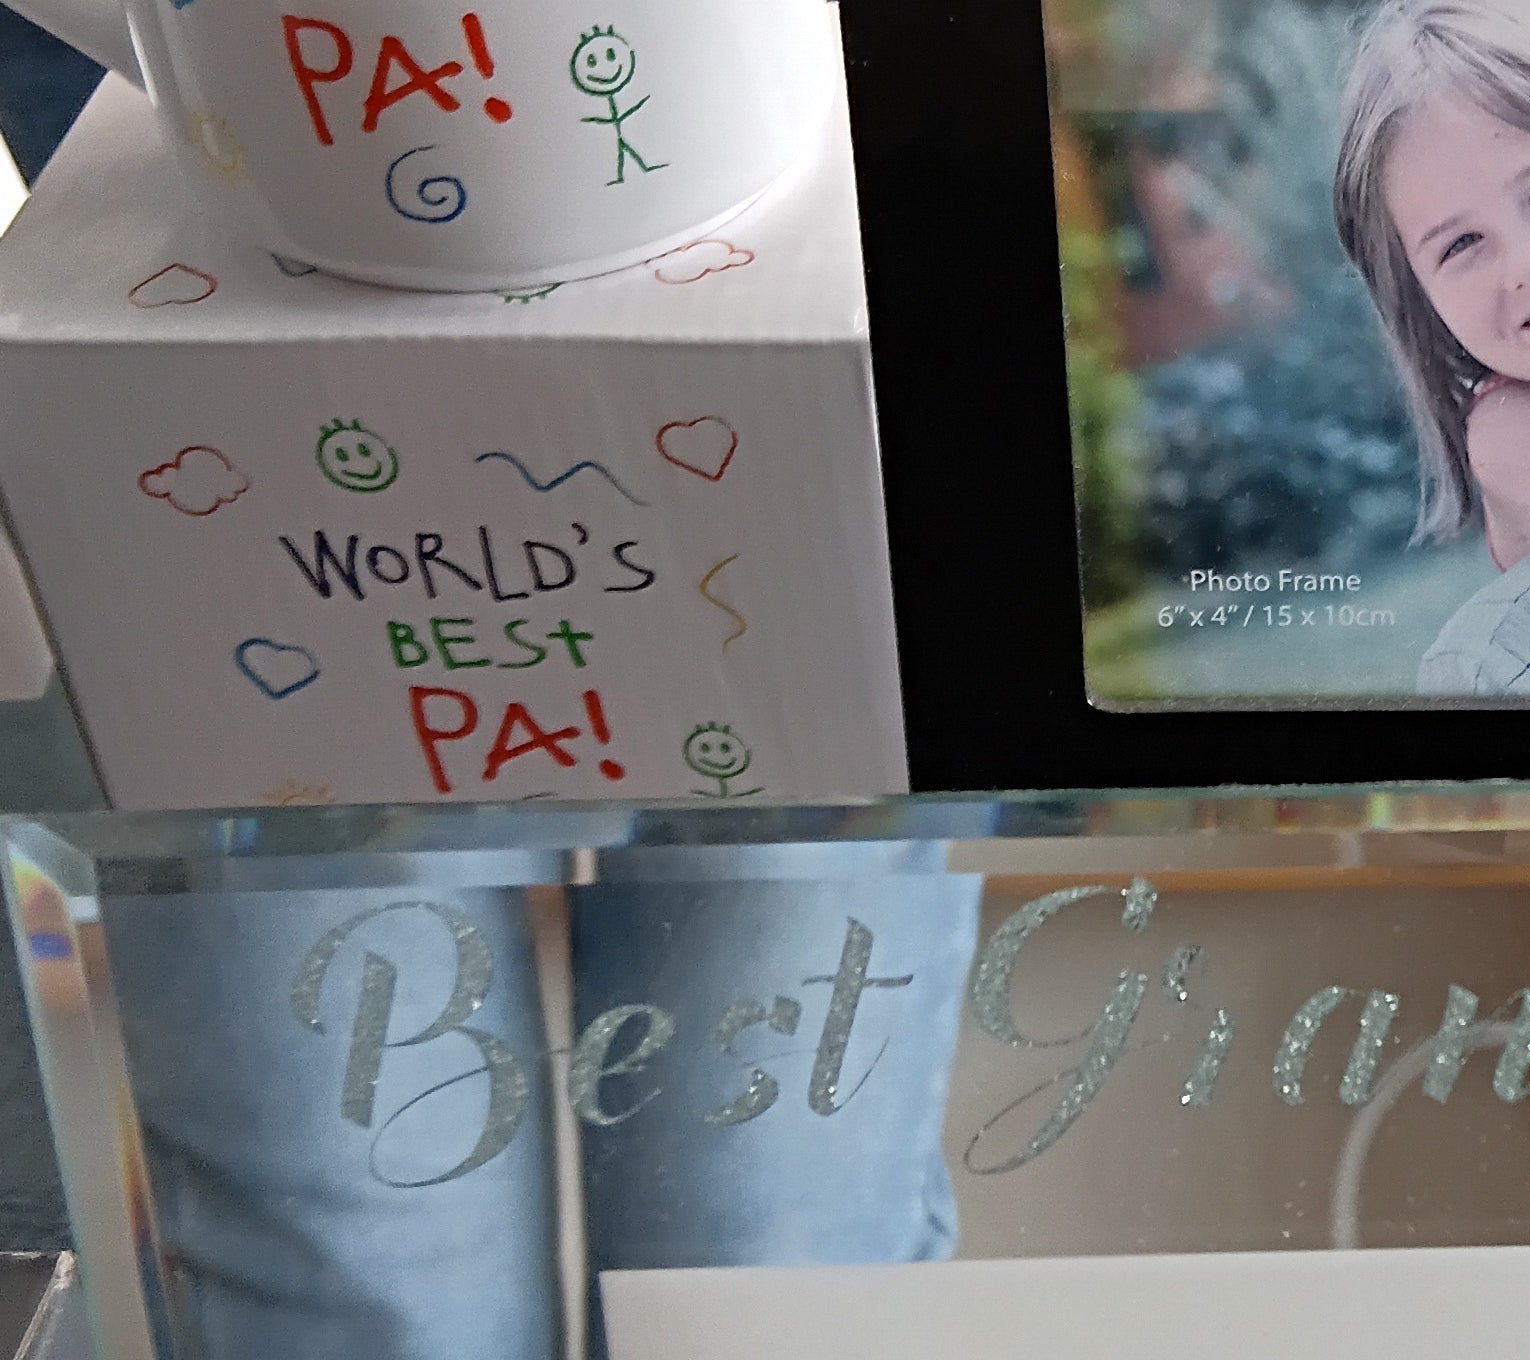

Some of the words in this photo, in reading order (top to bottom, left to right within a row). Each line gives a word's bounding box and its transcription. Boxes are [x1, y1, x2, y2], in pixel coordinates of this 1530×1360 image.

[281, 13, 513, 147] PA!
[279, 522, 655, 603] WORLD'S
[1190, 568, 1271, 592] Photo
[1278, 567, 1362, 592] Frame
[1263, 604, 1293, 627] 15
[1325, 604, 1396, 627] 10cm
[408, 686, 626, 793] PA!
[290, 900, 914, 1188] Best
